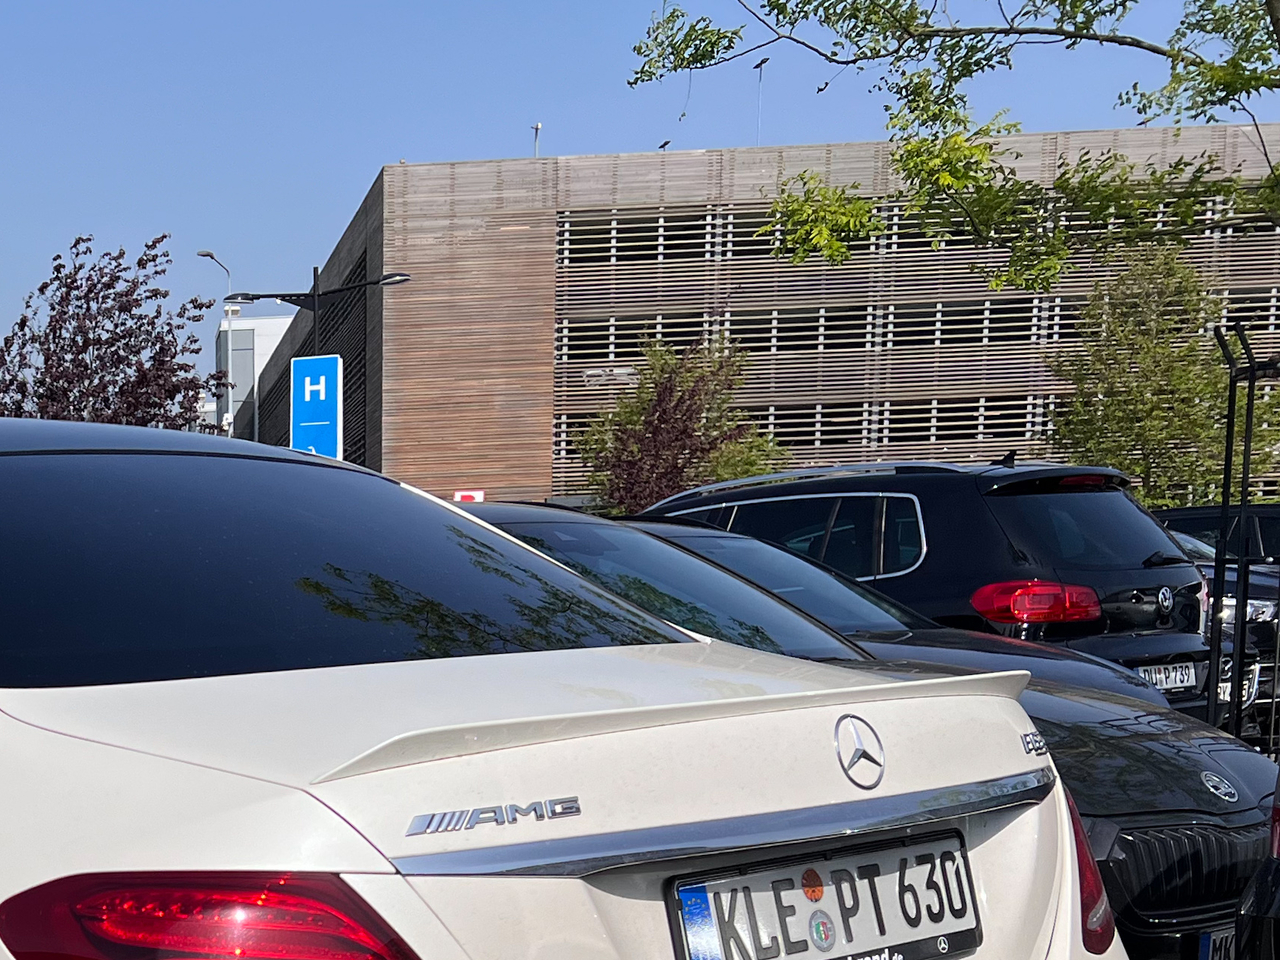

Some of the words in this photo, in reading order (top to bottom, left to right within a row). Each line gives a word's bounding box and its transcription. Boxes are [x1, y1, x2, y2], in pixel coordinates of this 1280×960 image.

[304, 375, 326, 402] H
[1164, 667, 1171, 686] P
[1172, 664, 1190, 685] 739
[464, 796, 581, 830] AMG
[831, 863, 886, 943] PT
[897, 850, 968, 928] 630
